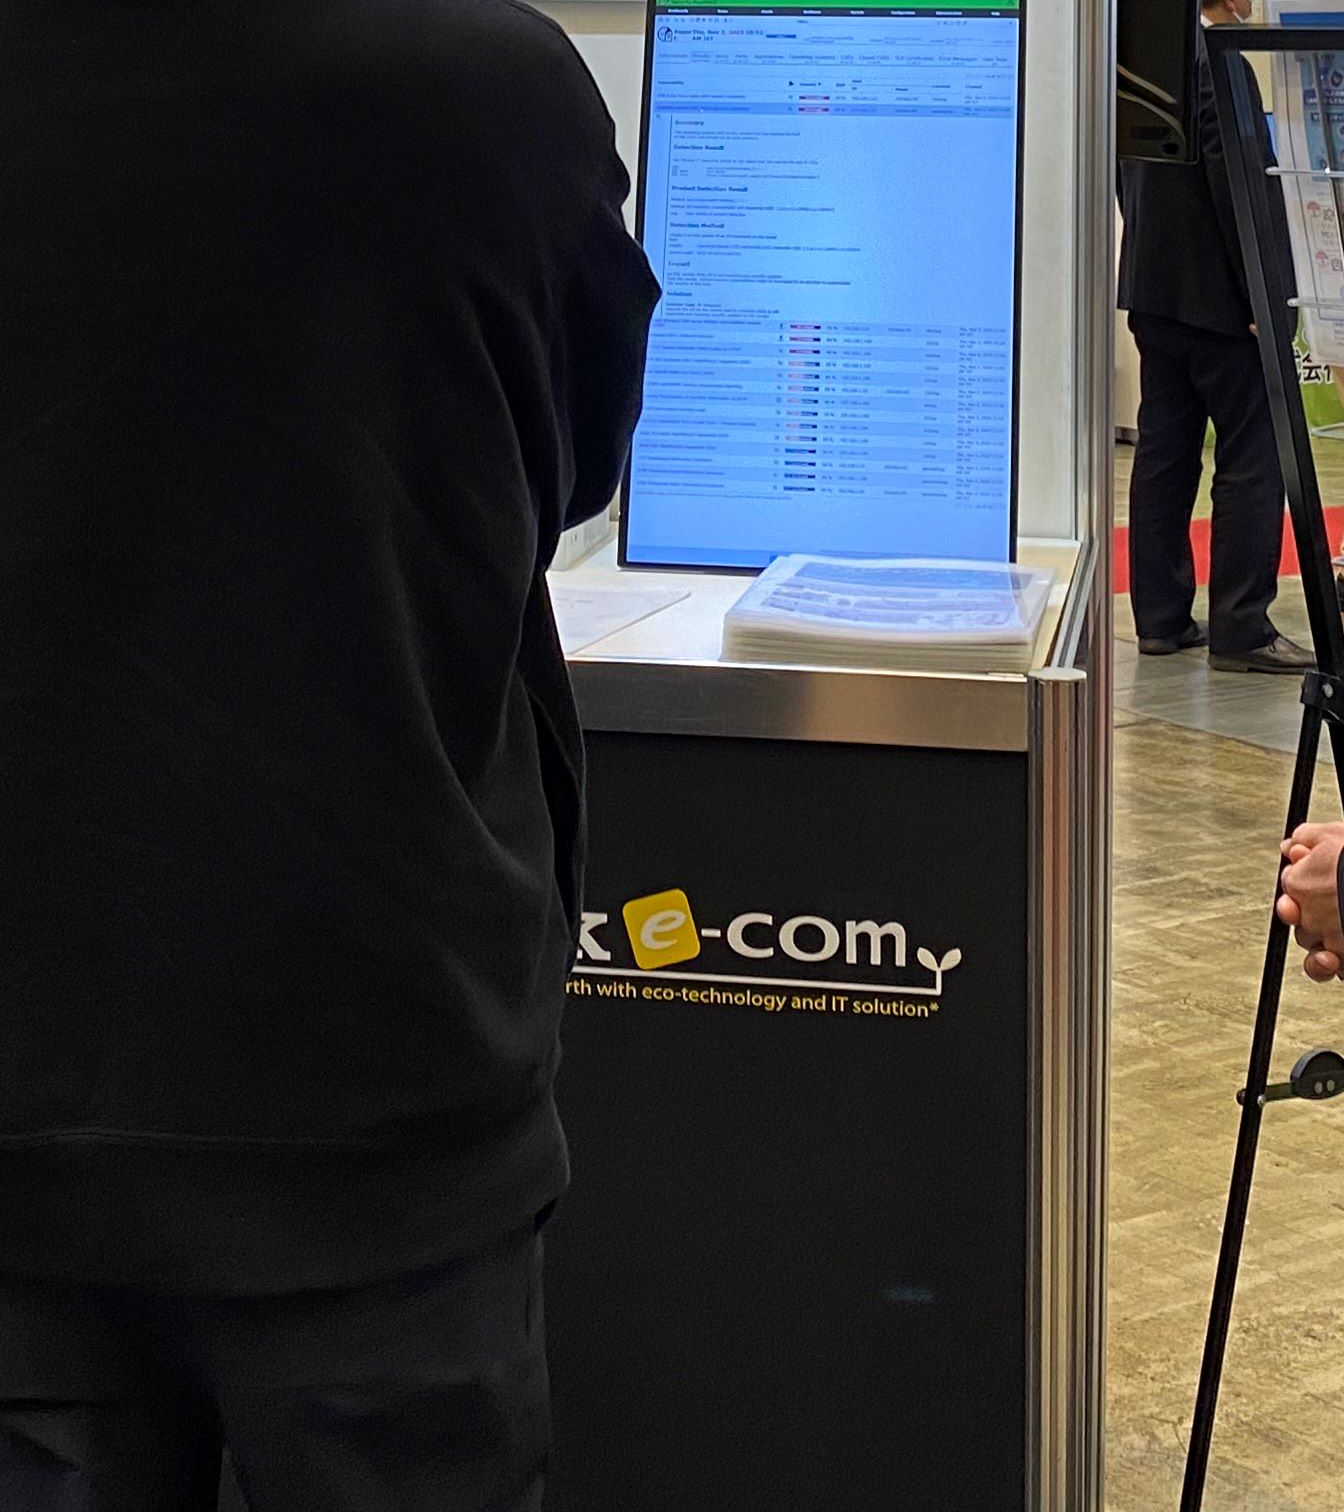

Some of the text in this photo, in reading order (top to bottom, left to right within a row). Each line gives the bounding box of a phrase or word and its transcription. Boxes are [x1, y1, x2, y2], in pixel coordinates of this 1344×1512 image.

[577, 912, 611, 962] k
[566, 980, 591, 996] rth
[597, 983, 637, 999] with
[642, 986, 786, 1012] eco-technology
[791, 994, 826, 1011] and
[832, 996, 849, 1011] IT
